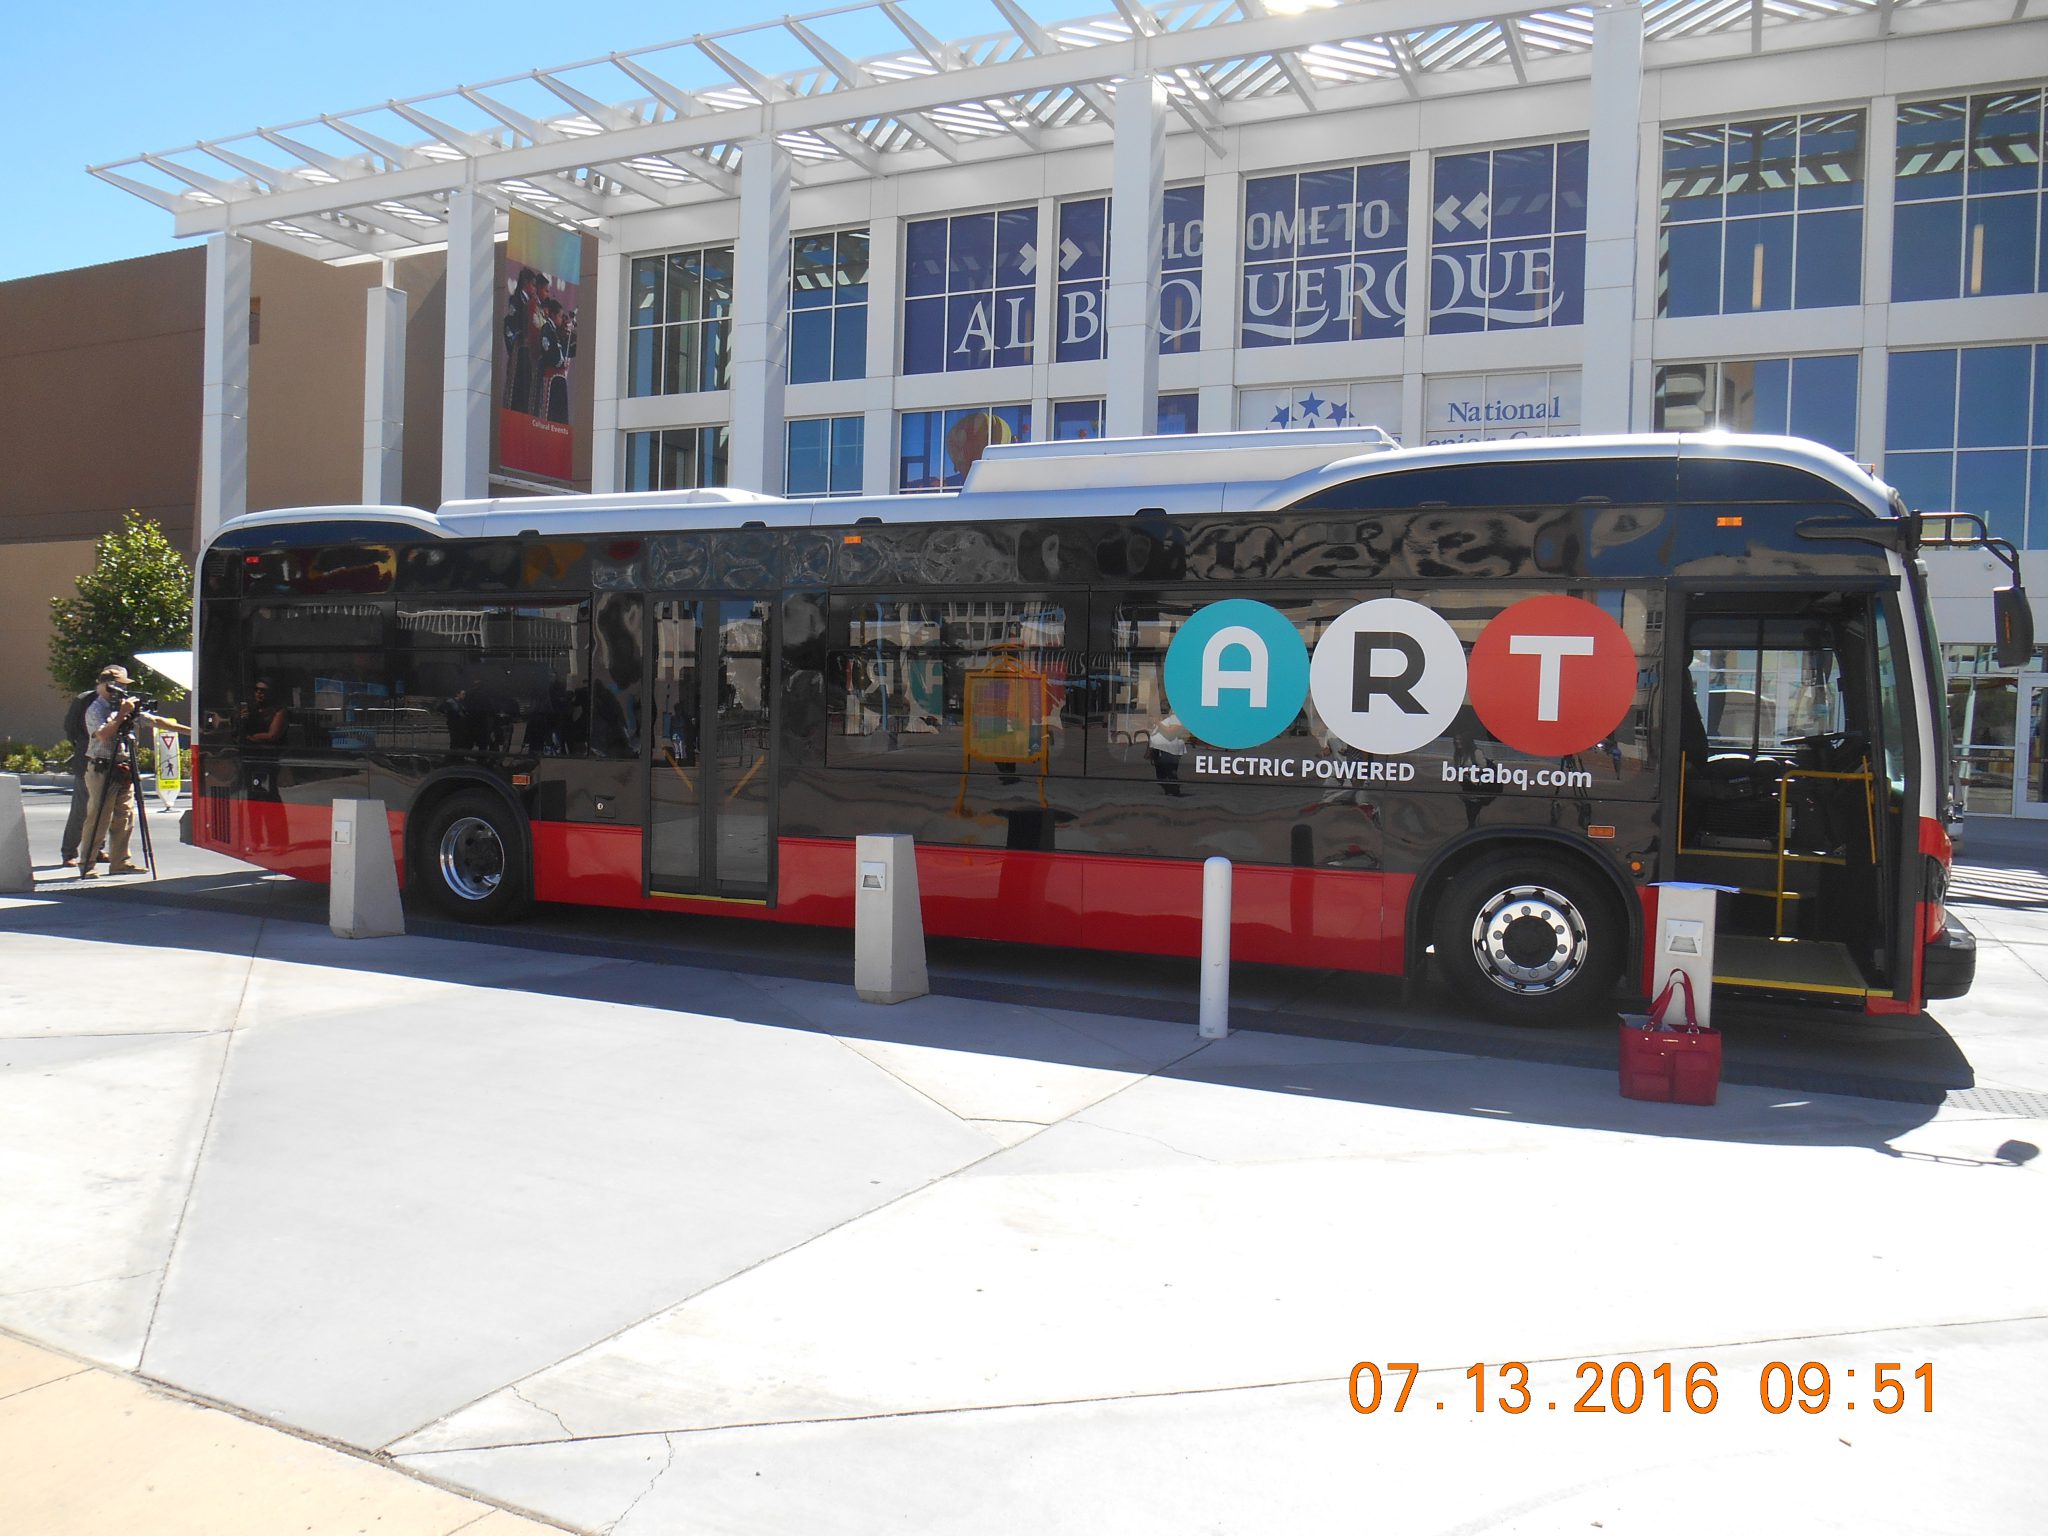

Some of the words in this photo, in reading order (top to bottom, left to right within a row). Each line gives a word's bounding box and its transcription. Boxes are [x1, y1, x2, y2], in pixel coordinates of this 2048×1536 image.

[1110, 204, 1330, 260] LCOME
[1337, 198, 1390, 241] TO
[953, 247, 1565, 353] ALBQUERQUE
[1448, 395, 1561, 423] National
[1195, 755, 1295, 777] ELECTRIC
[1301, 759, 1415, 782] POWERED
[1441, 760, 1592, 791] brtabq.com
